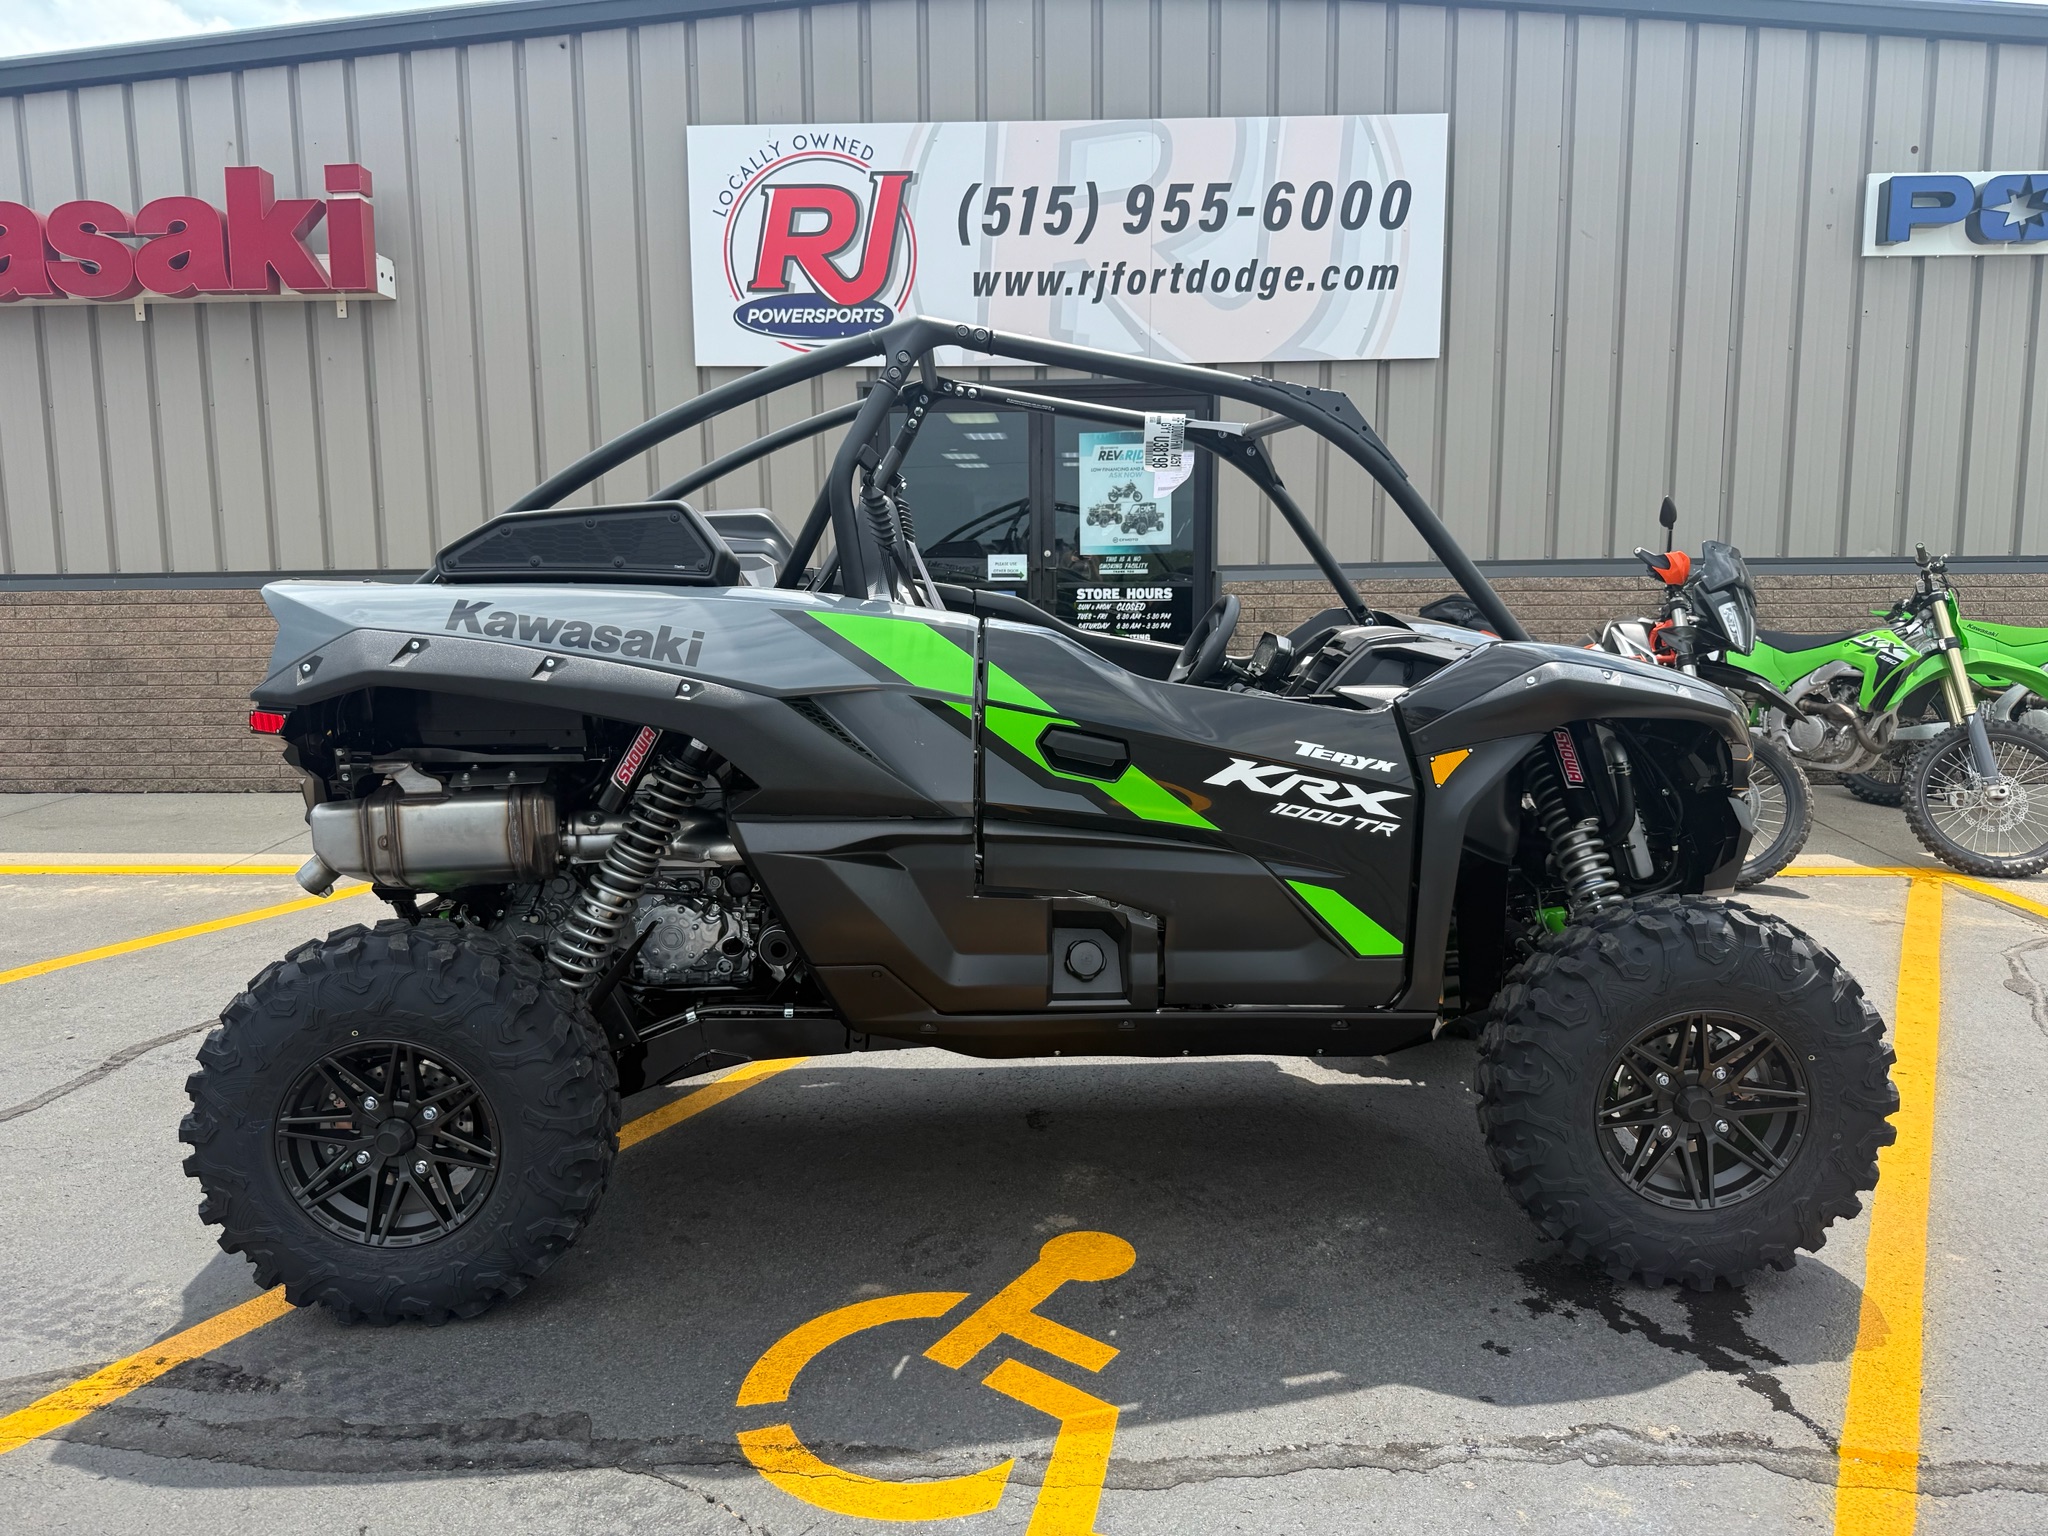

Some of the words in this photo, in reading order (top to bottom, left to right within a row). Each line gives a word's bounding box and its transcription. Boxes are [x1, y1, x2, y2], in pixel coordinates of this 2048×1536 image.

[712, 140, 781, 218] LOCALLY
[792, 133, 874, 161] OWNED
[957, 181, 1099, 247] (515)
[1122, 178, 1413, 236] 955-6000
[747, 170, 916, 306] RJ
[972, 258, 1400, 304] www.rjfortdodge.com
[746, 307, 886, 325] POWERSPORTS
[1097, 449, 1143, 462] REV&RID
[1152, 436, 1171, 469] U38198
[1076, 587, 1121, 600] STORE
[1126, 587, 1173, 600] HOURS
[1077, 603, 1092, 611] SUN
[1095, 602, 1112, 611] MON
[1116, 602, 1147, 611] CLOSED
[1077, 612, 1093, 620] TUES
[1096, 612, 1109, 620] FRI
[1078, 622, 1111, 630] SATURDAY
[1966, 623, 1999, 638] Kawasaki
[444, 598, 706, 668] Kawasaki
[1878, 654, 1899, 666] 450
[616, 725, 657, 787] SHOWA
[1553, 730, 1584, 783] SHOWA
[1202, 757, 1413, 820] KRX
